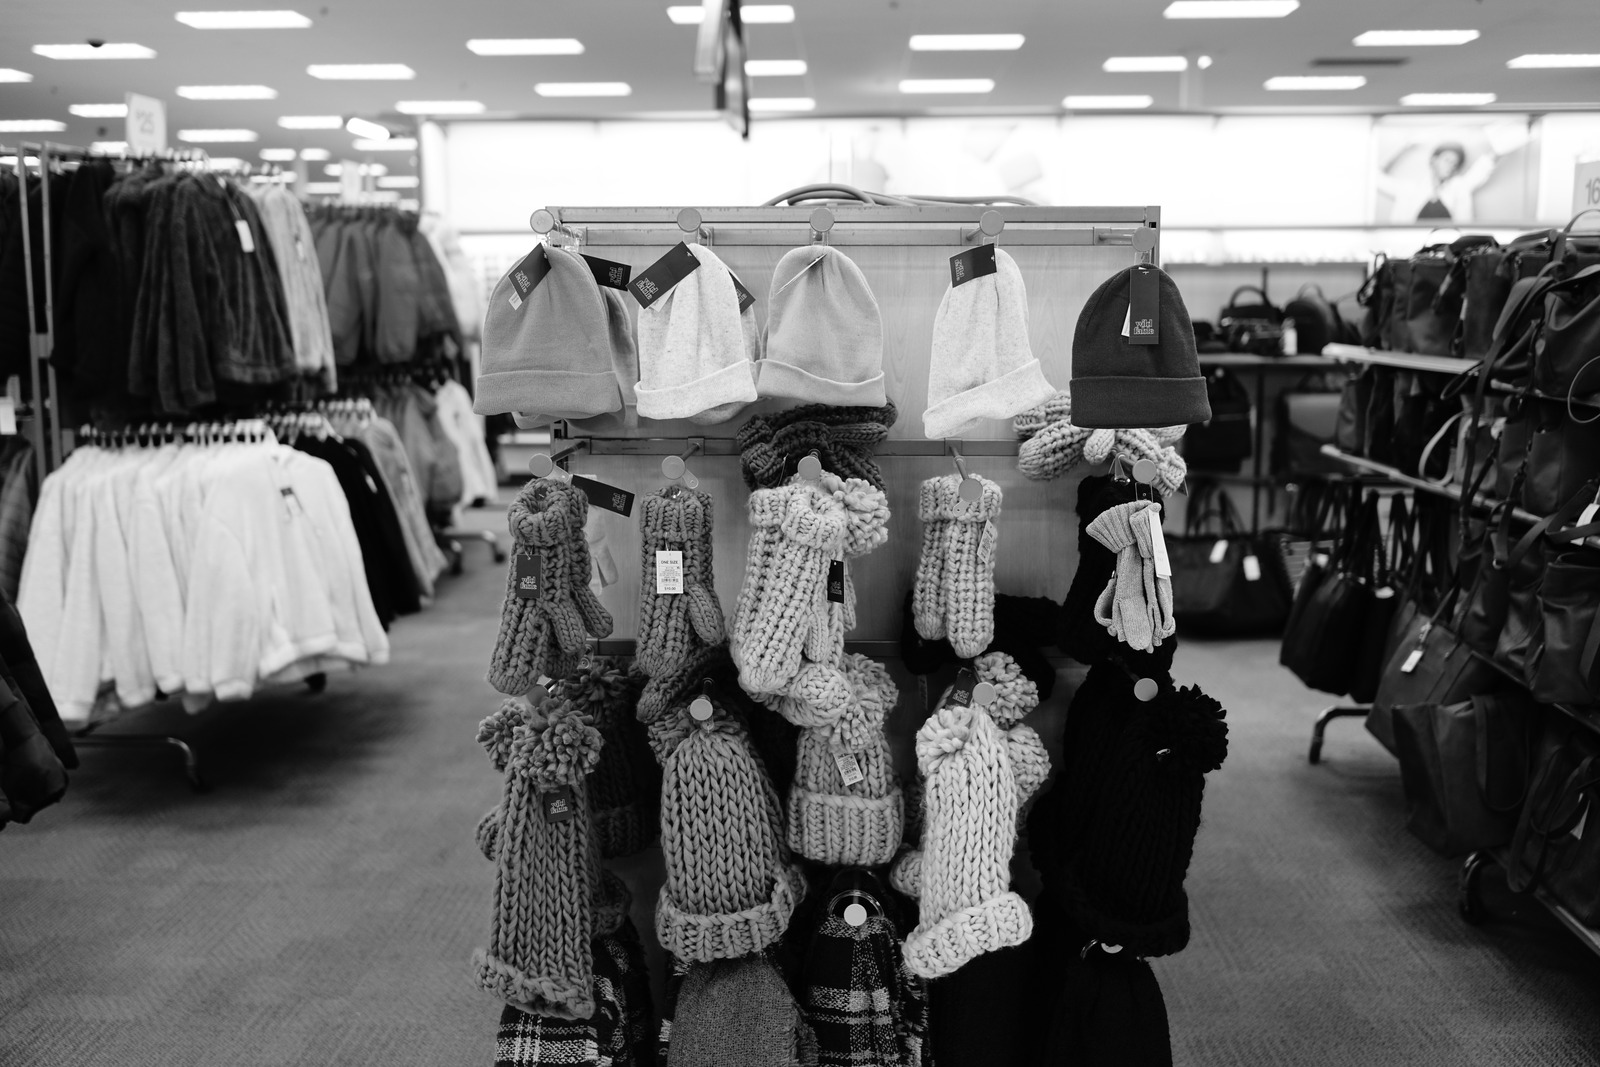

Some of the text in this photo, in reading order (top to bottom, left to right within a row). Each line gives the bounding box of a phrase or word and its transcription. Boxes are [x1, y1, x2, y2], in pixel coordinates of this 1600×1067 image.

[635, 280, 653, 300] fable
[643, 277, 659, 294] wild
[1135, 318, 1153, 328] wild
[1133, 326, 1155, 335] fable
